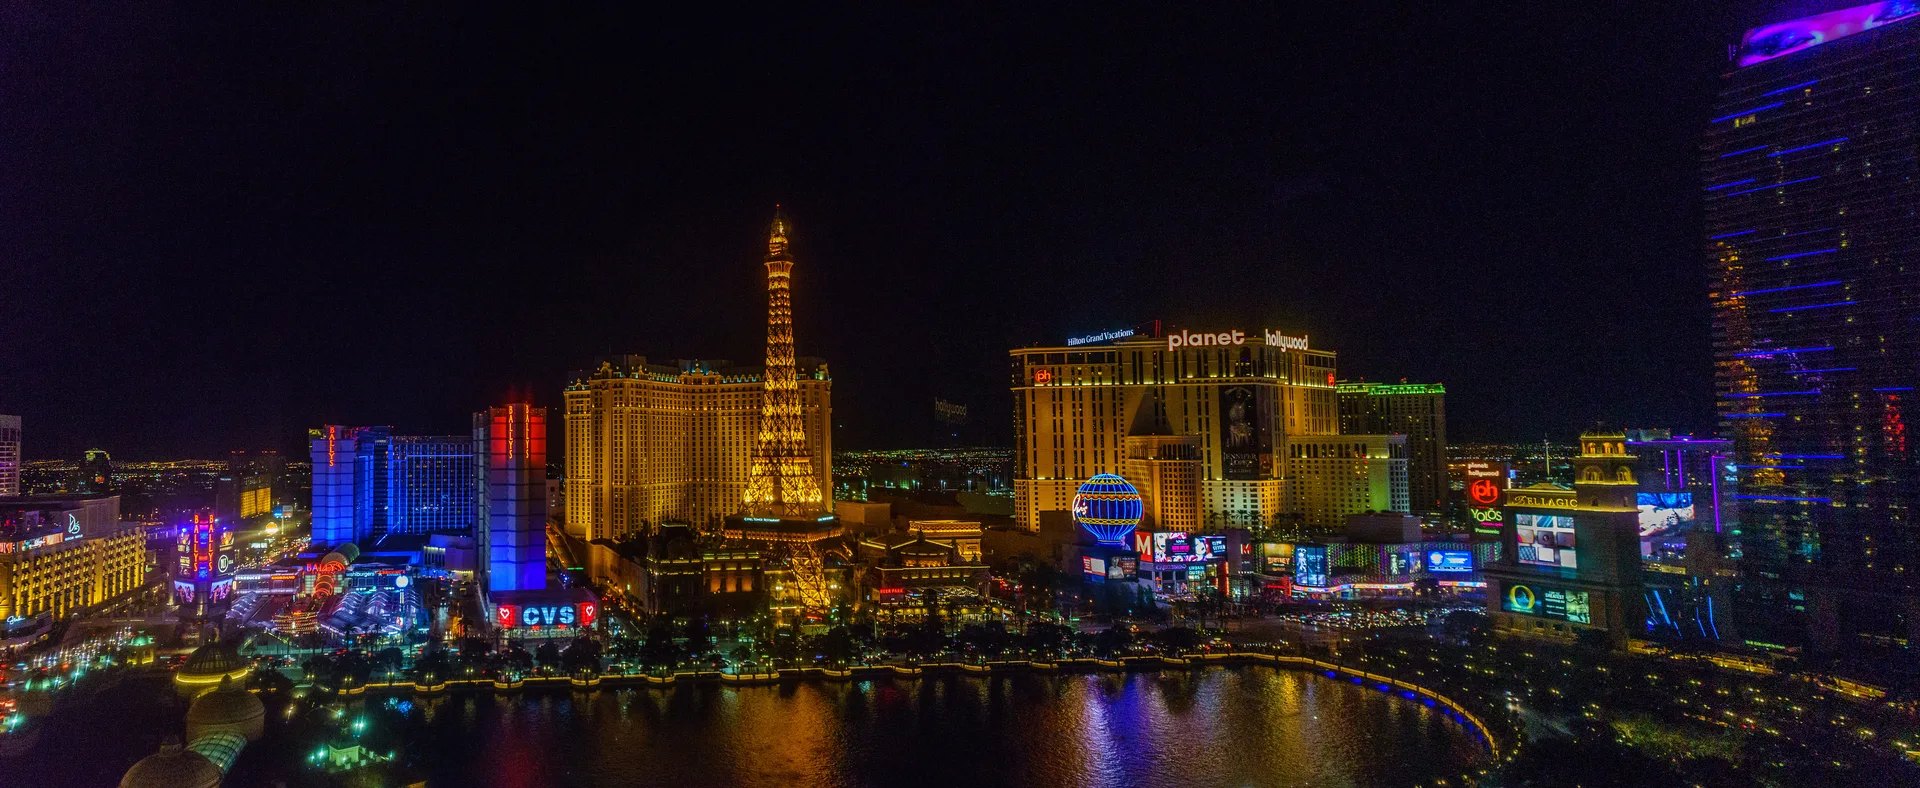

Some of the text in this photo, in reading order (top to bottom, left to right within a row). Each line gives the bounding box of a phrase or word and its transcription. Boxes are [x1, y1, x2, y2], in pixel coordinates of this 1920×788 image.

[1067, 328, 1134, 346] Hilton Grand Vacations
[1168, 329, 1246, 352] planet
[1265, 328, 1309, 353] hollywood
[1035, 369, 1051, 384] ph
[328, 426, 336, 467] BALLYS
[1467, 462, 1489, 470] planet
[1468, 469, 1500, 477] hollywood
[1471, 479, 1498, 504] ph
[1136, 533, 1152, 556] M
[522, 605, 575, 626] CVS
